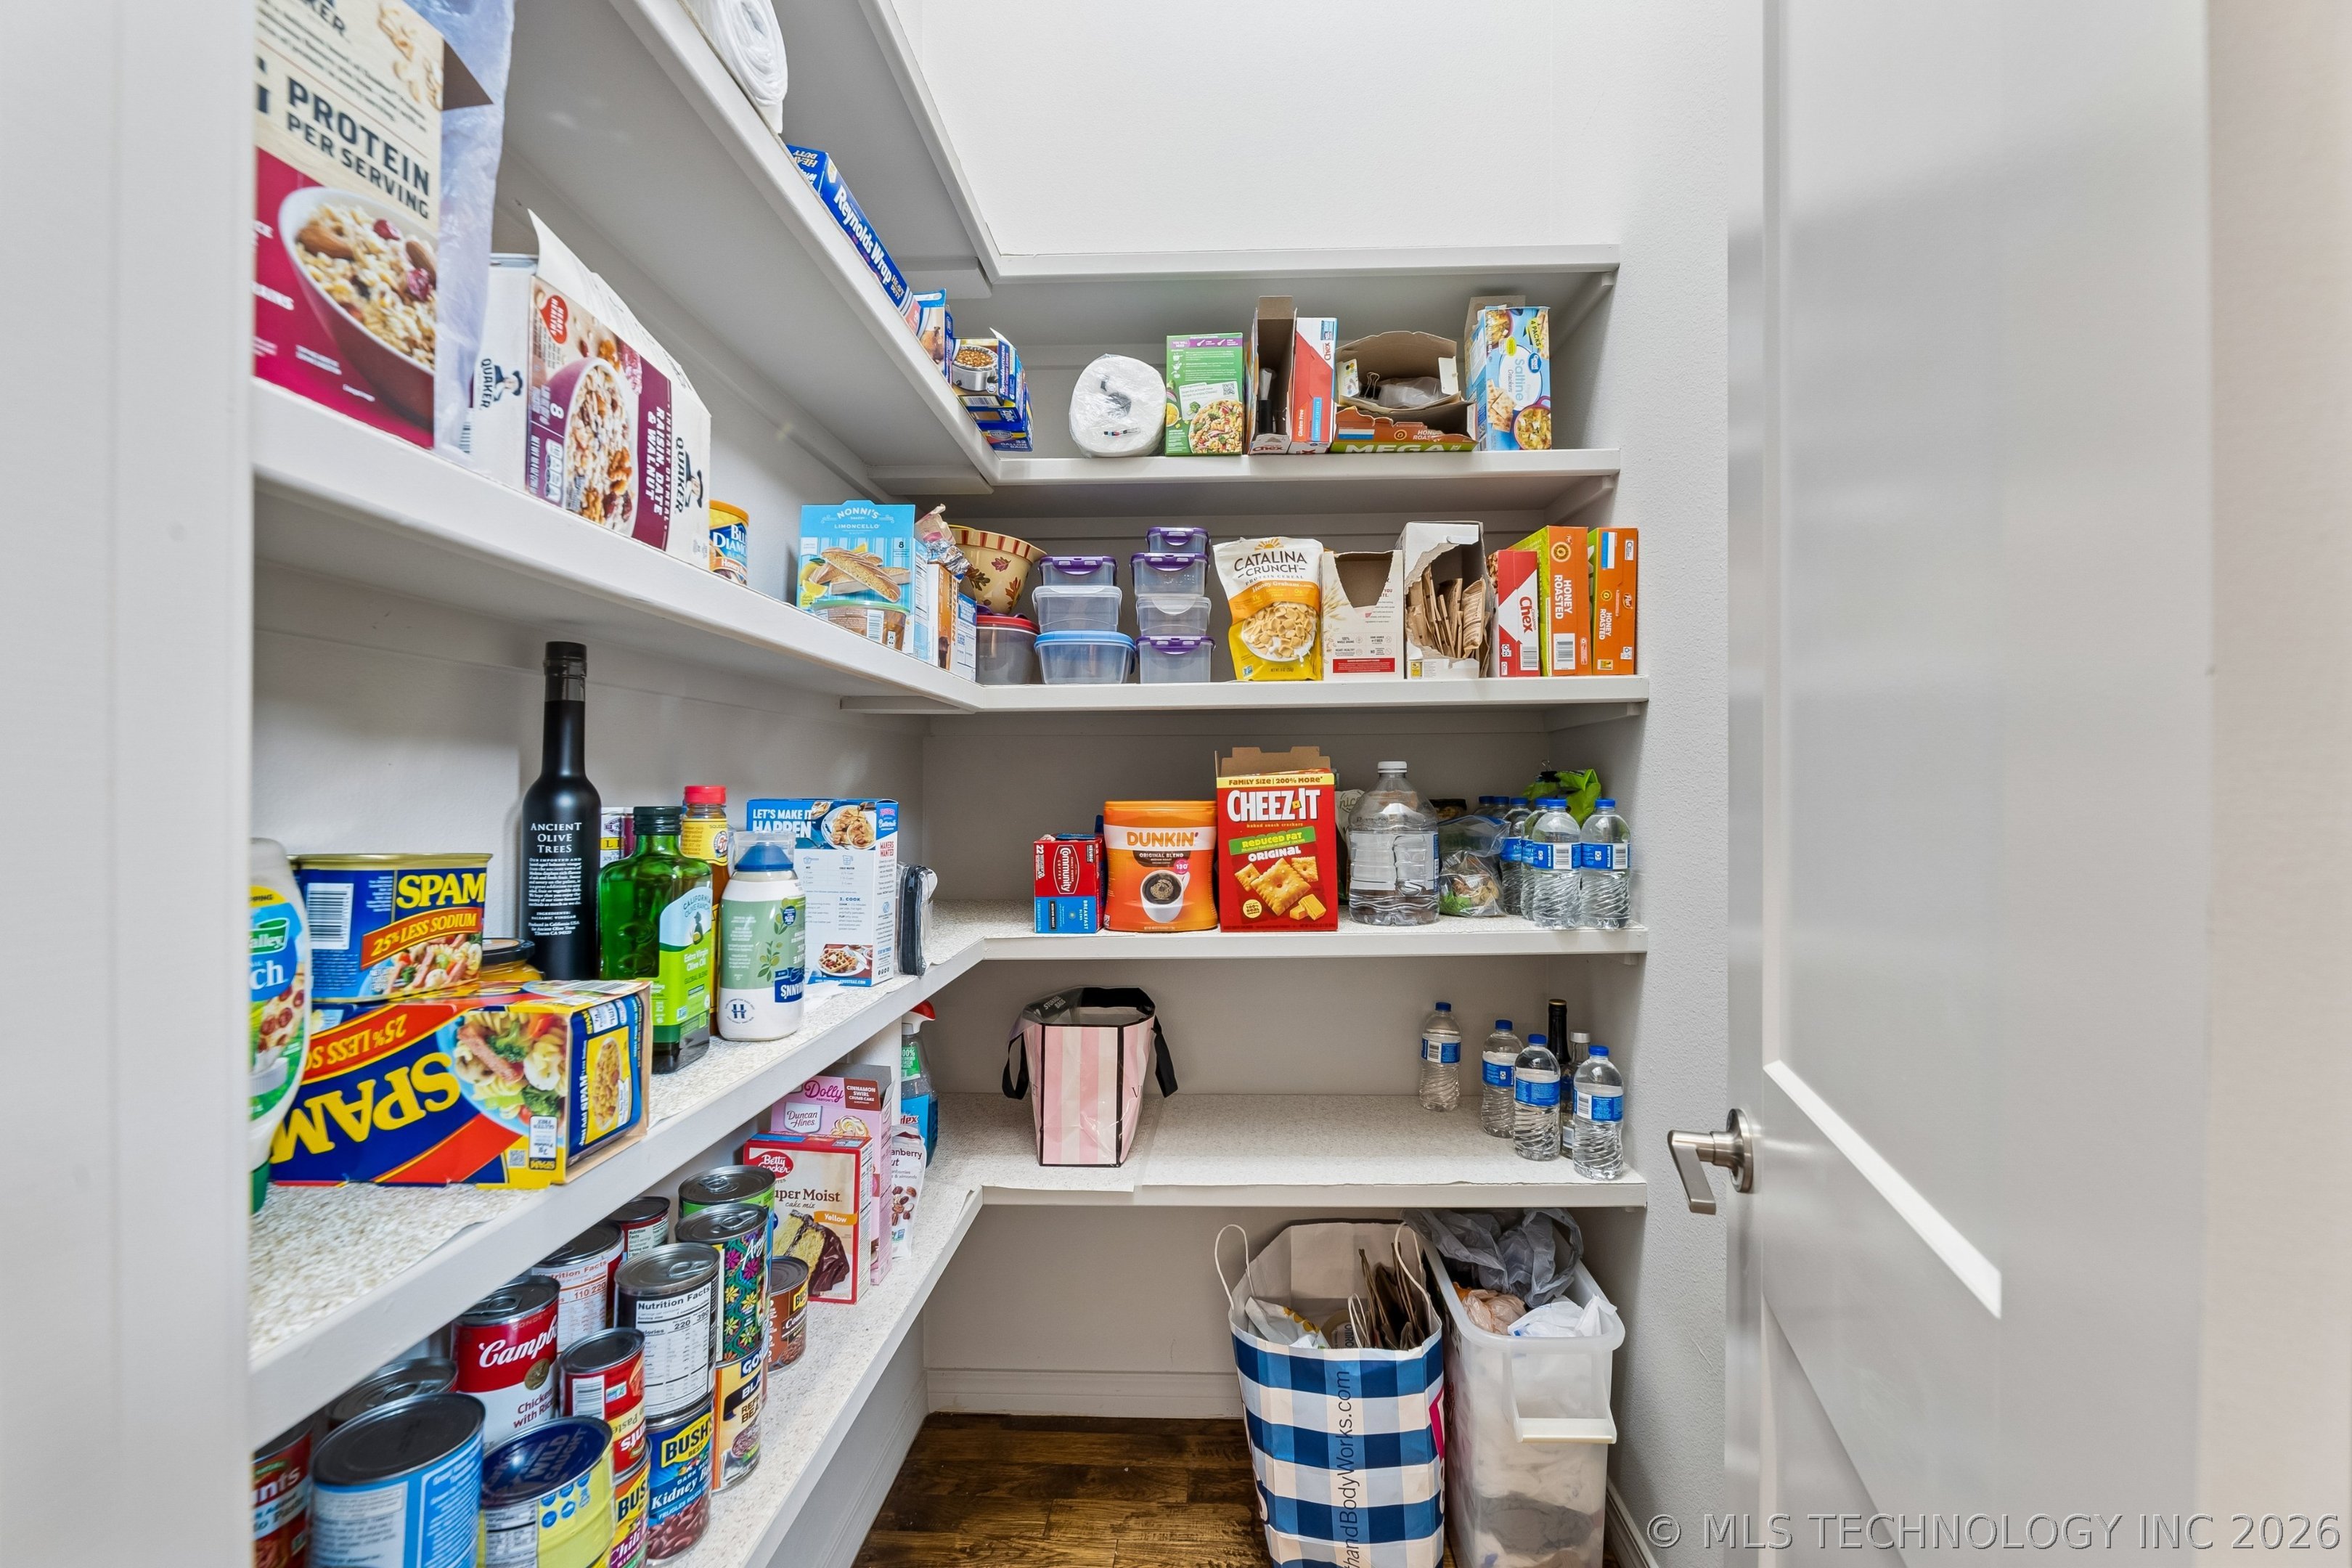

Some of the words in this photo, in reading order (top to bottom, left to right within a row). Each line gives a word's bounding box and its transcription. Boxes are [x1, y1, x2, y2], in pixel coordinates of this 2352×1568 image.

[286, 75, 429, 197] PROTEIN
[286, 110, 335, 158] PER
[340, 147, 429, 219] SERVING
[792, 150, 818, 160] DUTY
[833, 184, 874, 254] Reynolds
[870, 242, 892, 284] Wrap
[891, 274, 905, 295] HEAVY
[1531, 327, 1542, 347] PACKS
[479, 358, 494, 409] QUAKER
[1515, 359, 1526, 401] Saltine
[550, 403, 565, 420] 8
[648, 411, 656, 424] &
[645, 428, 657, 501] WALNUT
[674, 436, 685, 514] QUAKER
[653, 471, 665, 515] DATE
[836, 507, 881, 520] NONNI'S
[1234, 550, 1307, 572] CATALINA
[1246, 564, 1298, 576] CRUNCH
[1245, 575, 1275, 586] PROTEIN
[1251, 581, 1272, 593] Honey
[1553, 574, 1564, 620] ROASTED
[1564, 579, 1573, 614] HONEY
[1519, 596, 1533, 632] Chex
[752, 809, 776, 820] LET'S
[777, 809, 803, 820] MAKE
[804, 808, 811, 820] IT
[530, 822, 582, 831] ANCIENT
[752, 821, 812, 838] HAPPEN
[537, 833, 573, 842] OLIVE
[1126, 831, 1199, 847] DUNKIN'
[537, 844, 572, 854] TREES
[1036, 844, 1044, 854] 22
[1060, 847, 1071, 892] Community
[396, 873, 486, 909] SPAM
[682, 892, 711, 910] CALIFORNIA
[249, 932, 286, 951] alley
[370, 933, 400, 957] 25%
[399, 920, 430, 944] LESS
[431, 912, 478, 935] SODIUM
[372, 1013, 408, 1040] 25%
[324, 1029, 372, 1065] LESS
[901, 1048, 916, 1058] 00%
[579, 1074, 592, 1111] SPAM
[804, 1080, 844, 1103] Dolly
[269, 1052, 461, 1166] SPAM
[786, 1110, 818, 1120] Duncan
[790, 1119, 815, 1129] Hines
[760, 1154, 787, 1168] Betty
[891, 1148, 923, 1160] anberry
[775, 1188, 801, 1203] uper
[803, 1188, 841, 1203] Moist
[824, 1213, 847, 1224] Yellow
[584, 1259, 608, 1273] Facts
[573, 1290, 589, 1299] 110
[591, 1281, 606, 1294] 220
[637, 1298, 684, 1310] Nutrition
[686, 1285, 711, 1302] Facts
[674, 1318, 691, 1331] 220
[696, 1309, 709, 1322] 390
[643, 1328, 665, 1337] lories
[513, 1410, 537, 1429] with
[687, 1443, 705, 1458] BEST
[677, 1469, 697, 1486] DARK
[651, 1479, 698, 1511] Kidney
[610, 1527, 641, 1564] Chili
